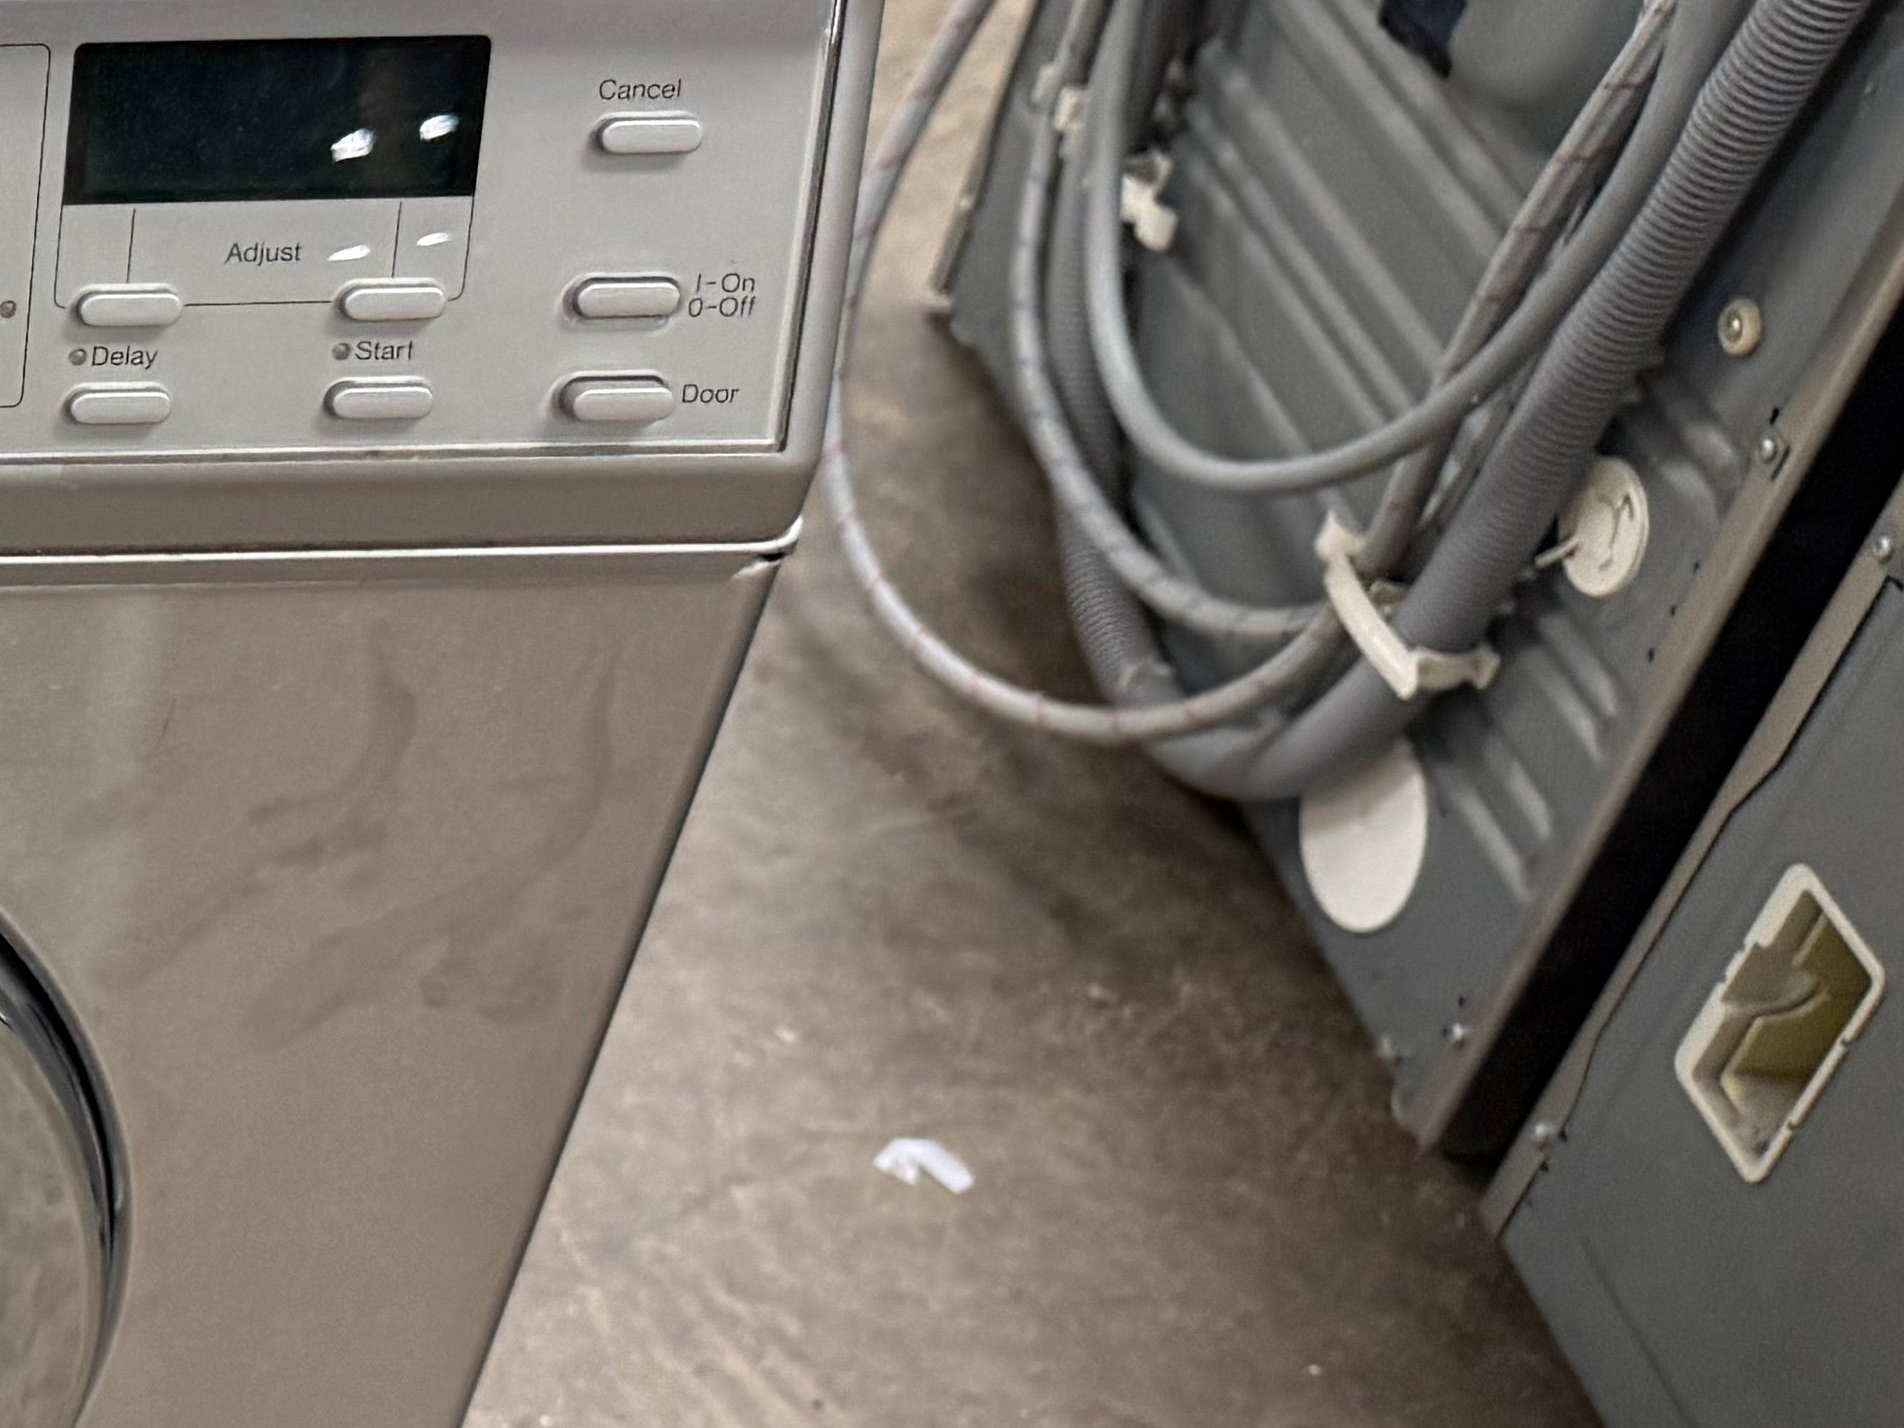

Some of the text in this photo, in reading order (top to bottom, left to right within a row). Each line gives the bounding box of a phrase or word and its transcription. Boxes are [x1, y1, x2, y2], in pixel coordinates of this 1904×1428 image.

[598, 78, 683, 100] Cancel
[225, 241, 302, 266] Adjust
[91, 344, 159, 372] Delay
[354, 339, 415, 363] Start
[681, 384, 740, 406] Door
